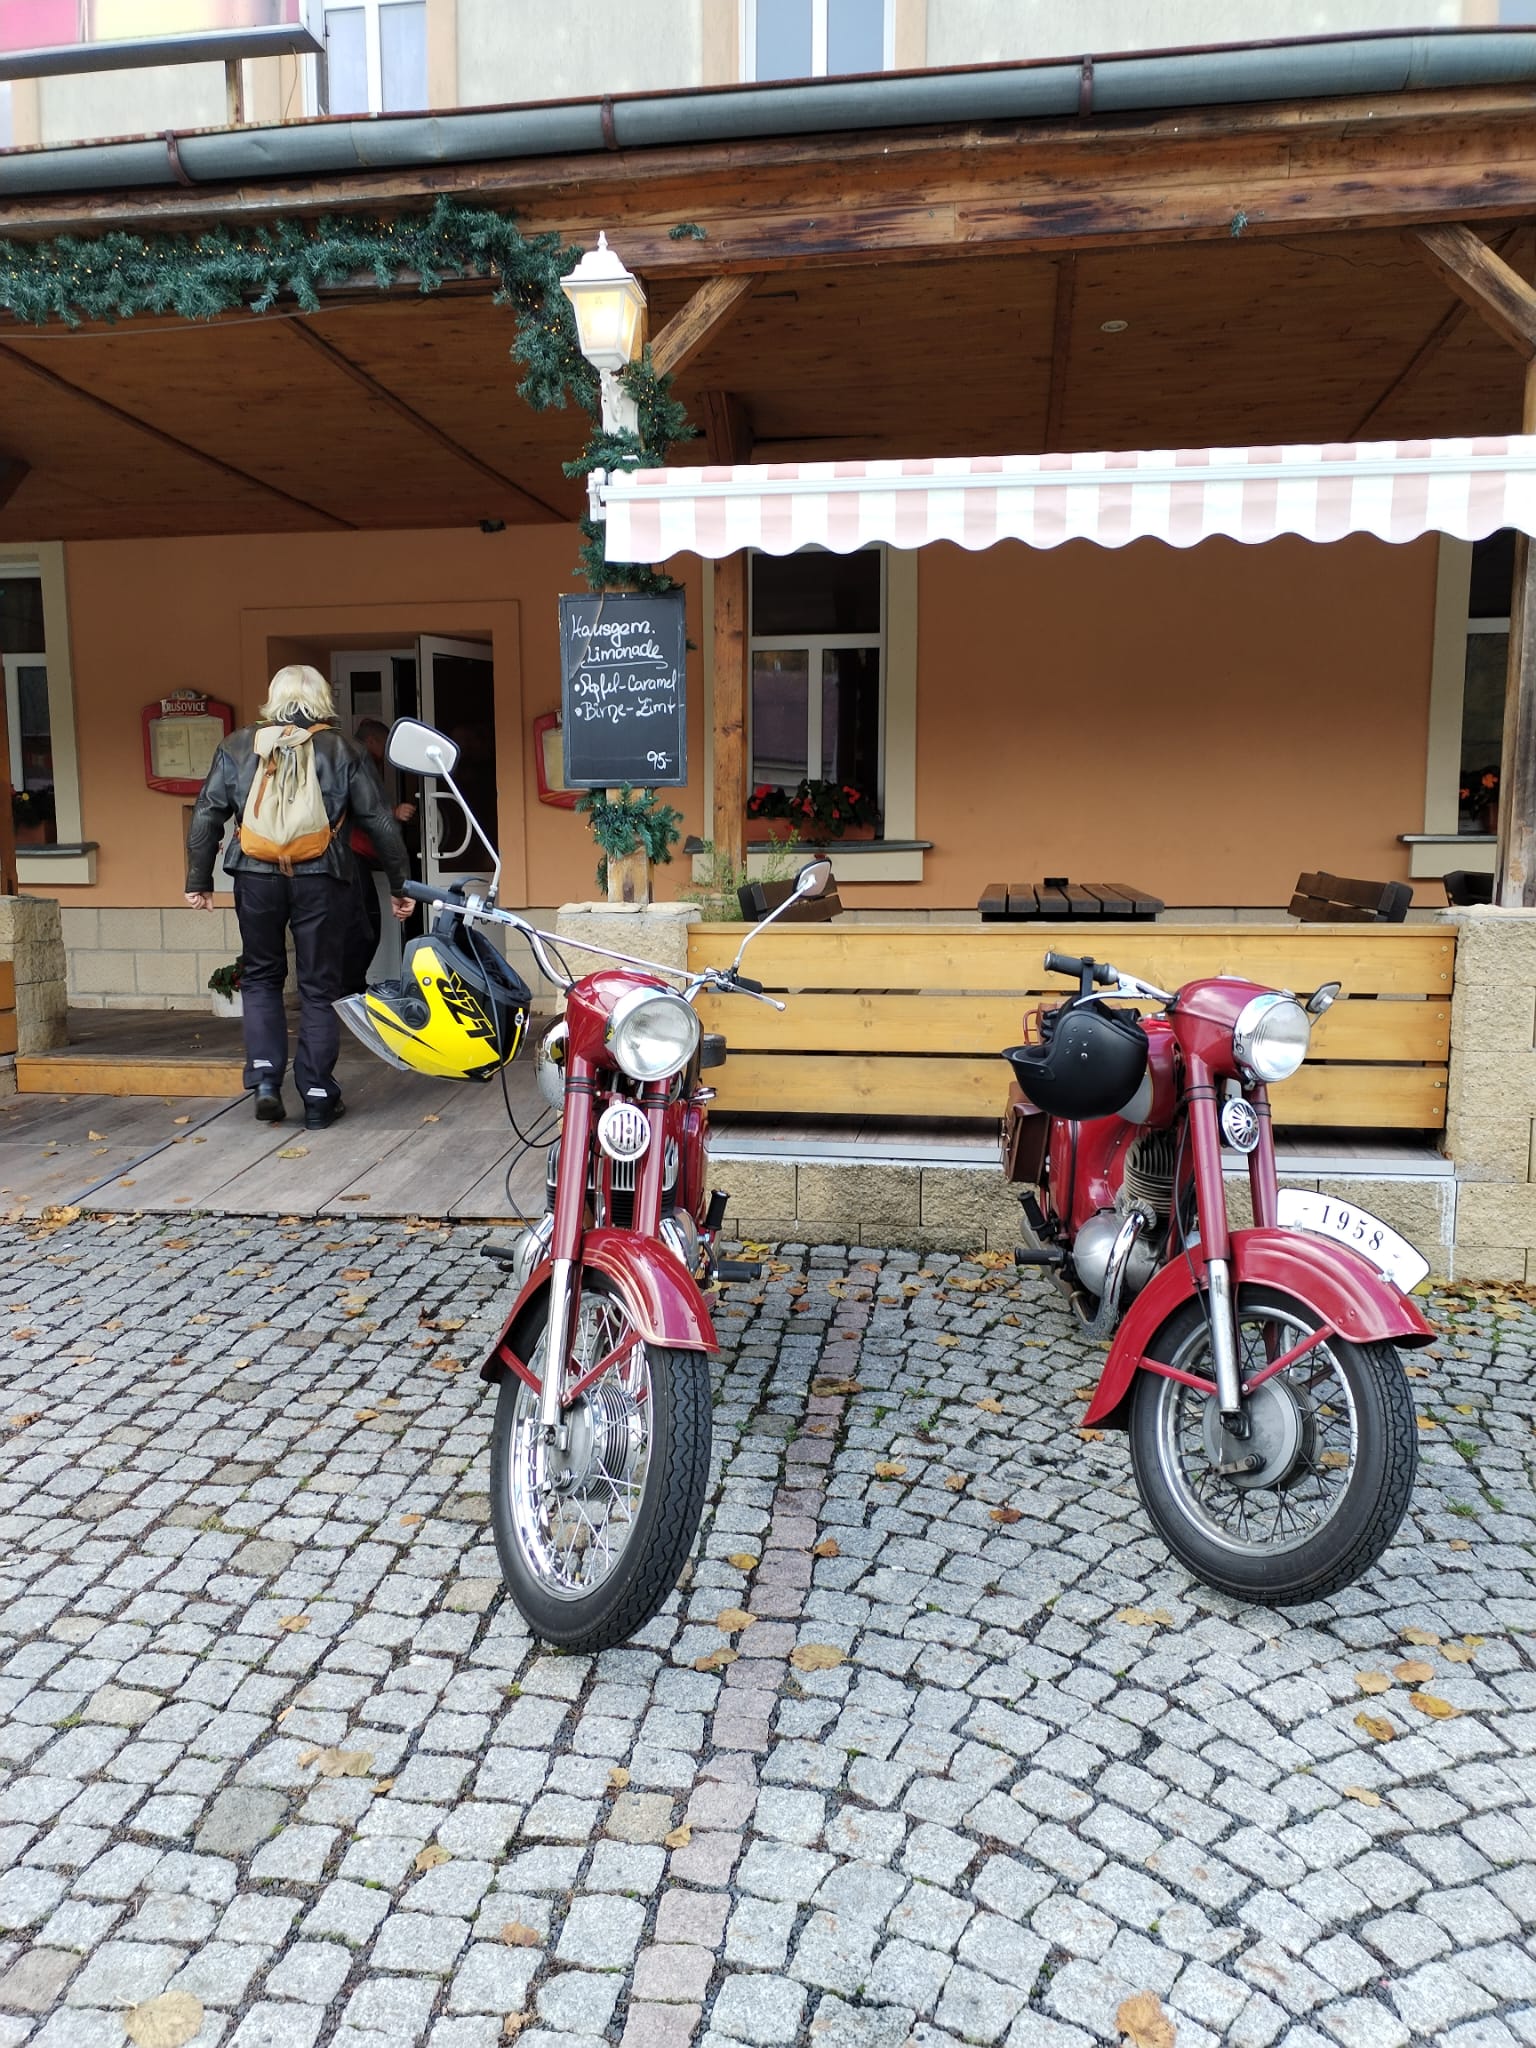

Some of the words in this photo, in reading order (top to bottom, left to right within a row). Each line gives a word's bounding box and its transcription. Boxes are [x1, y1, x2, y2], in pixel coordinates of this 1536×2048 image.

[571, 614, 656, 648] Hausgem.
[586, 639, 664, 663] Limonade
[435, 971, 497, 1039] LZR
[1322, 1205, 1384, 1251] 1958
